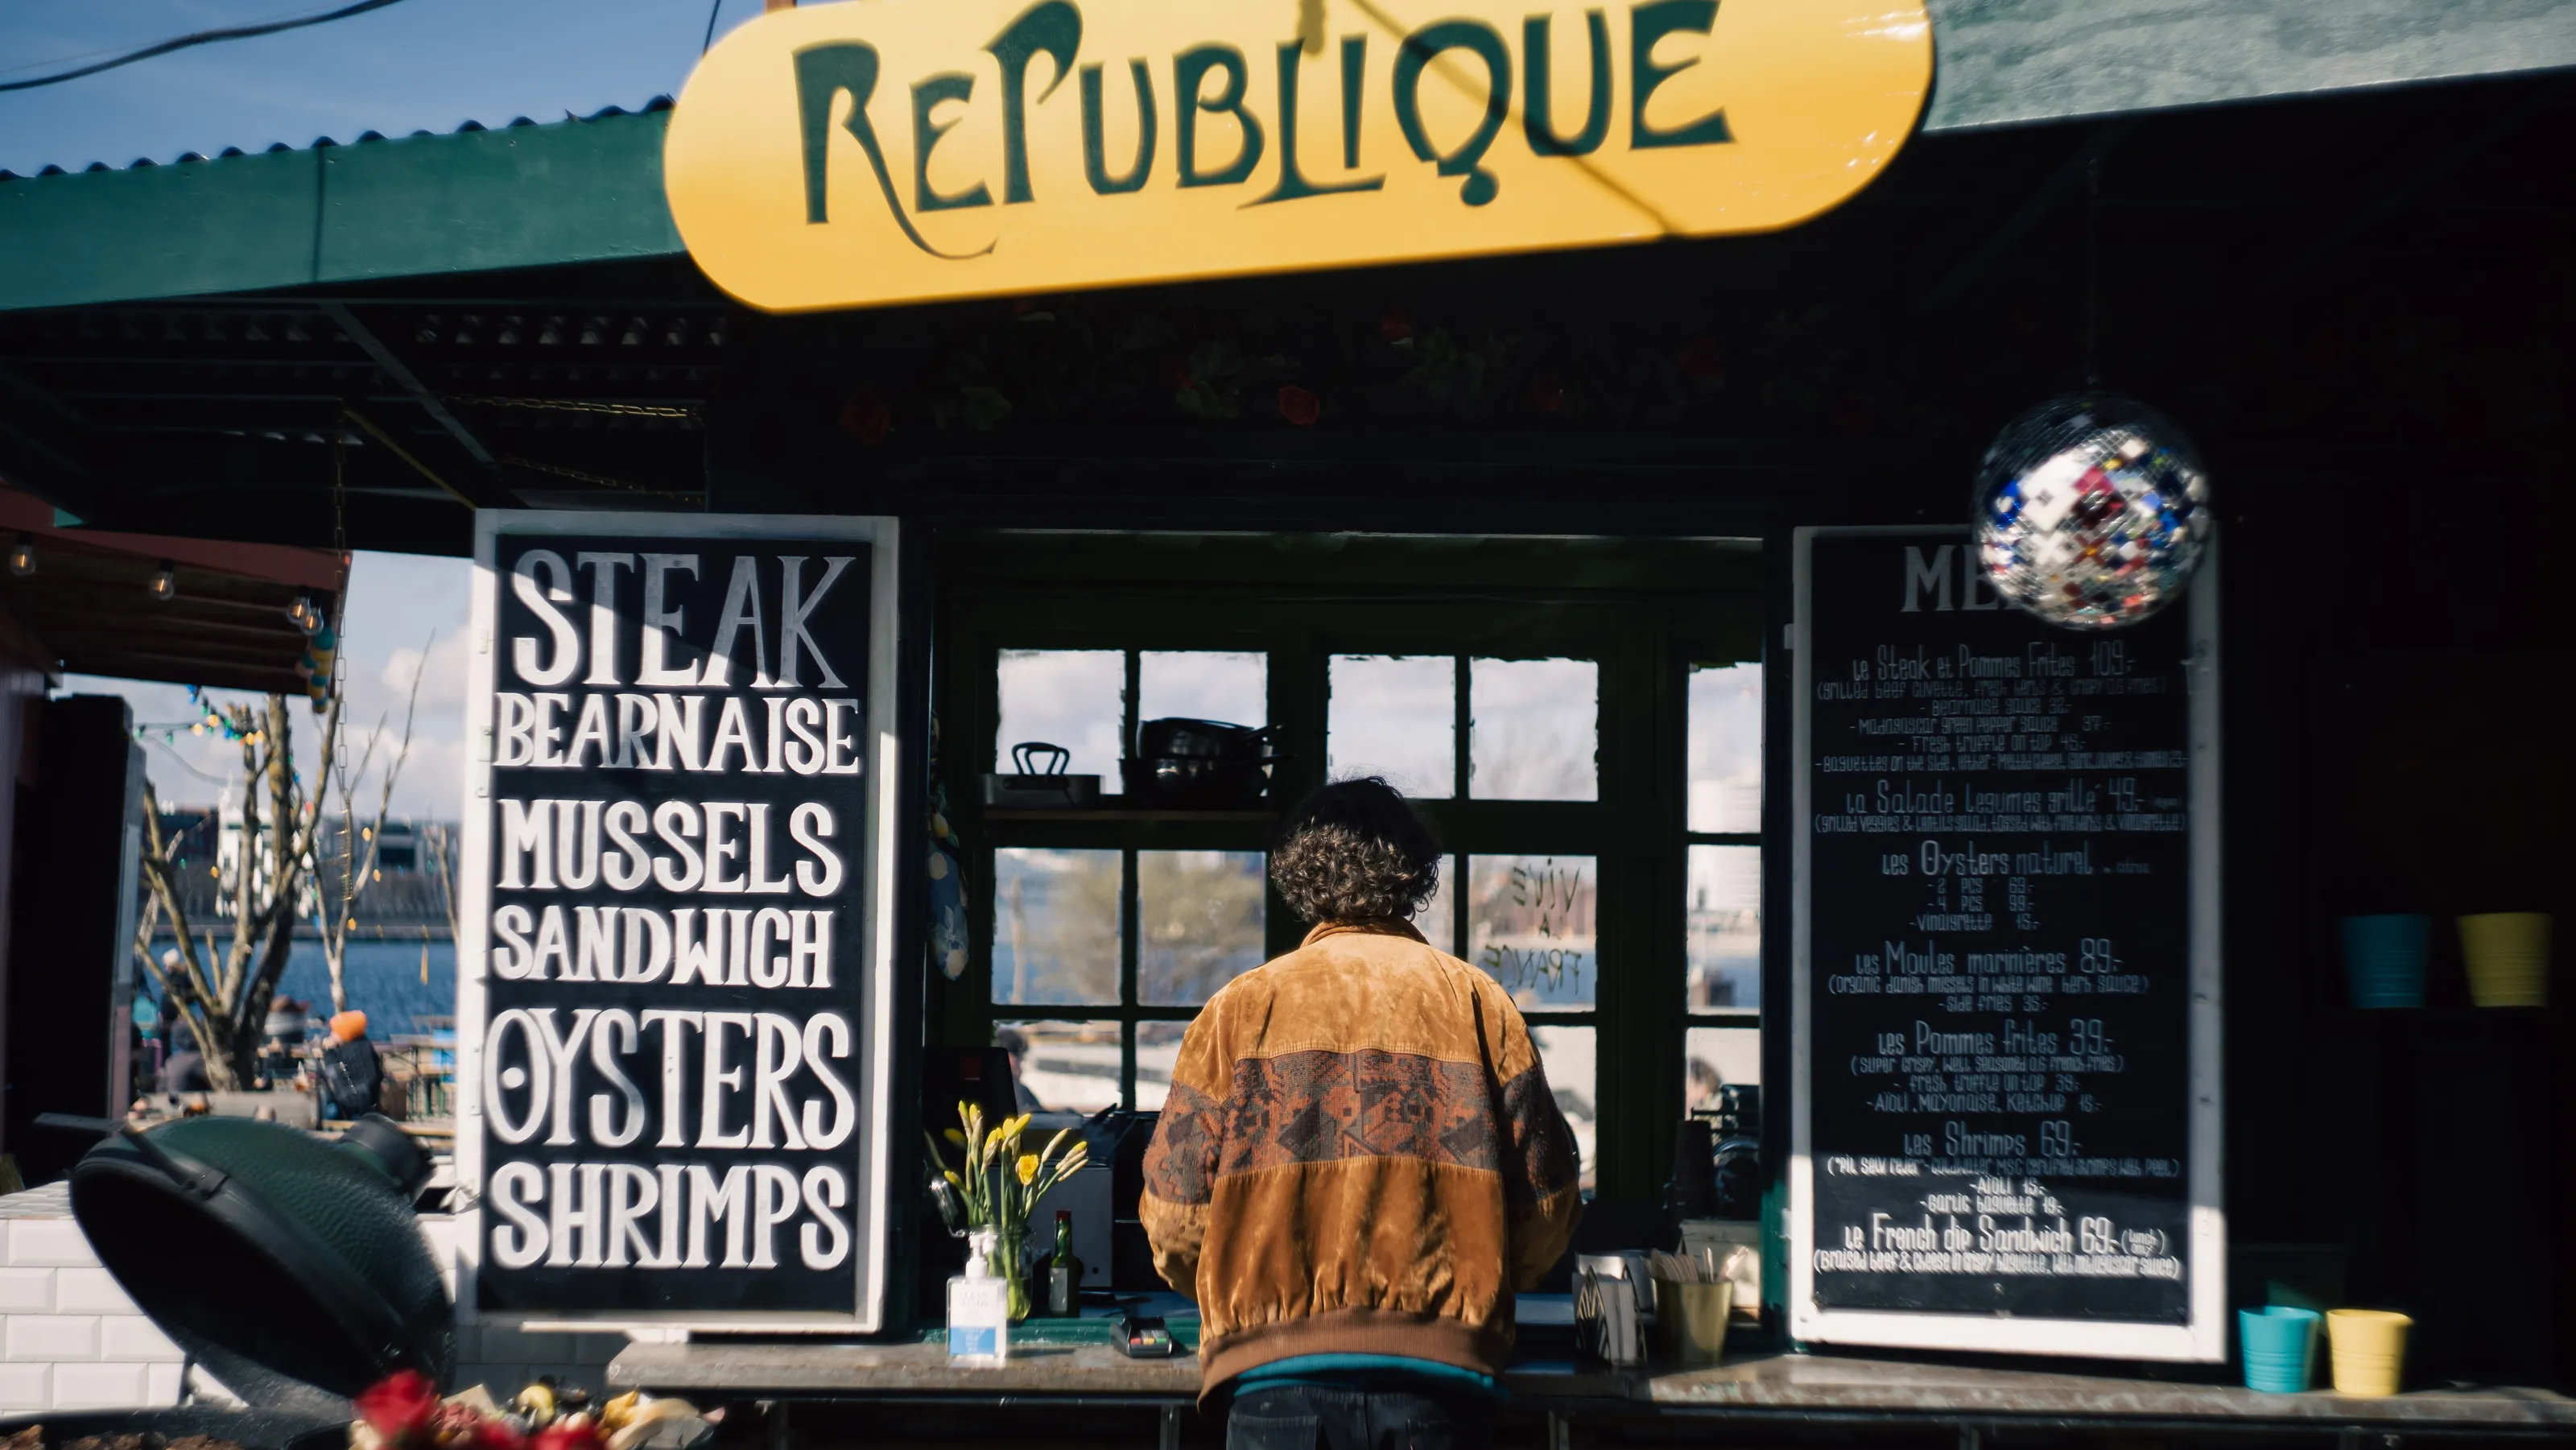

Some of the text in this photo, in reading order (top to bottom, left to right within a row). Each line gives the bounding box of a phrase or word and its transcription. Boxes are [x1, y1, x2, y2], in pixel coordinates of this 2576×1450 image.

[791, 0, 1736, 259] REPUBLIQUE
[1900, 544, 2025, 612] ME
[512, 549, 857, 688] STEAK
[1877, 644, 1932, 680] Steak
[1937, 656, 1953, 679] et
[1958, 642, 2021, 678] Pommes
[2028, 642, 2075, 677] Frites
[2051, 679, 2064, 696] &
[492, 692, 859, 775] BEARNAISE
[1876, 779, 1955, 814] Salade
[1901, 815, 1913, 832] &
[2104, 813, 2116, 831] &
[496, 799, 842, 897] MUSSELS
[1921, 840, 2010, 876] Oysters
[1937, 877, 1946, 894] 2
[1937, 894, 1946, 911] 4
[493, 904, 834, 989] SANDWICH
[1885, 939, 1955, 975] Moules
[1978, 974, 1988, 993] in
[1916, 1019, 1995, 1055] Pommes
[484, 1007, 855, 1150] OYSTERS
[2003, 1074, 2019, 1092] on
[1945, 1120, 2029, 1157] Shrimps
[489, 1161, 850, 1270] SHRIMPS
[1872, 1212, 1940, 1252] French
[1943, 1214, 1975, 1252] dip
[1979, 1214, 2074, 1254] Sandwich
[1898, 1250, 1913, 1274] &
